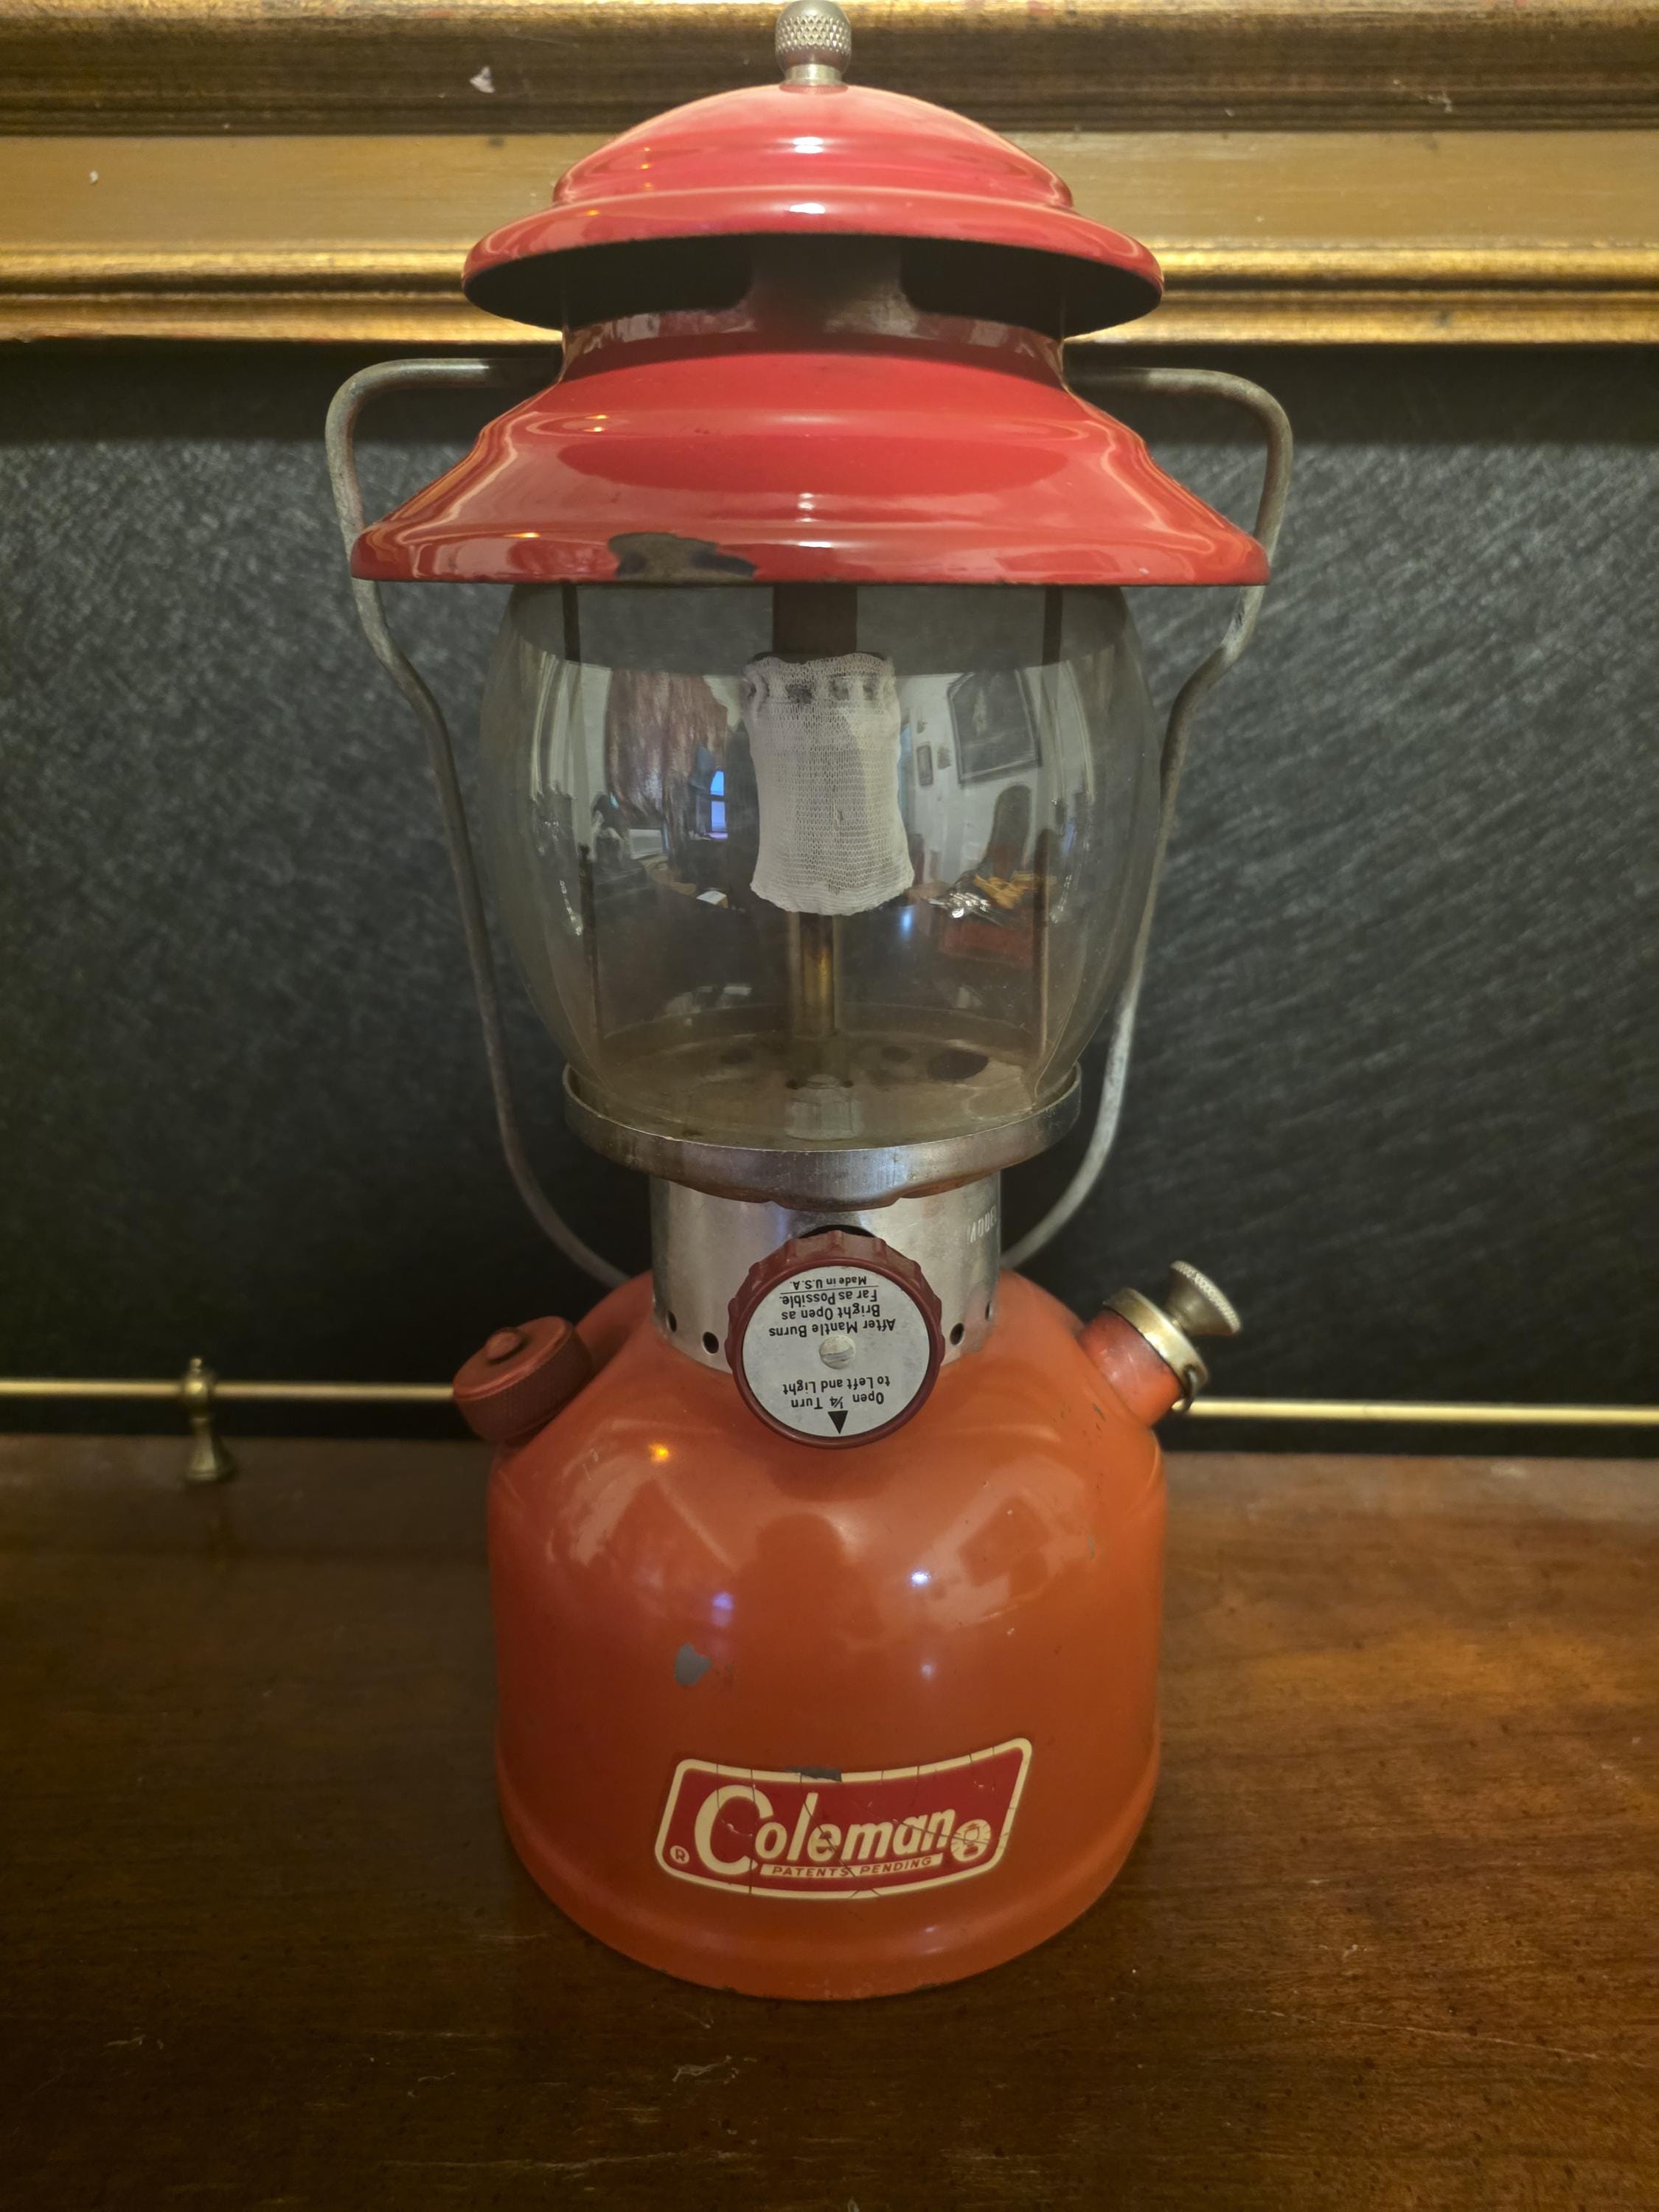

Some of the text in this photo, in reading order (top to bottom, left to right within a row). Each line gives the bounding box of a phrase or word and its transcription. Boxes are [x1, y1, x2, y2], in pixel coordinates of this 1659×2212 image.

[839, 1276, 866, 1285] Made
[779, 1290, 877, 1308] Far as Possible.
[782, 1304, 880, 1320] Bright Open as
[768, 1318, 896, 1338] After Mantle Burns
[782, 1376, 890, 1395] to Left and Light
[790, 1397, 824, 1410] Turn
[852, 1391, 884, 1405] Open
[694, 1784, 956, 1875] Coleman
[772, 1857, 933, 1877] PATENTS PENDING
